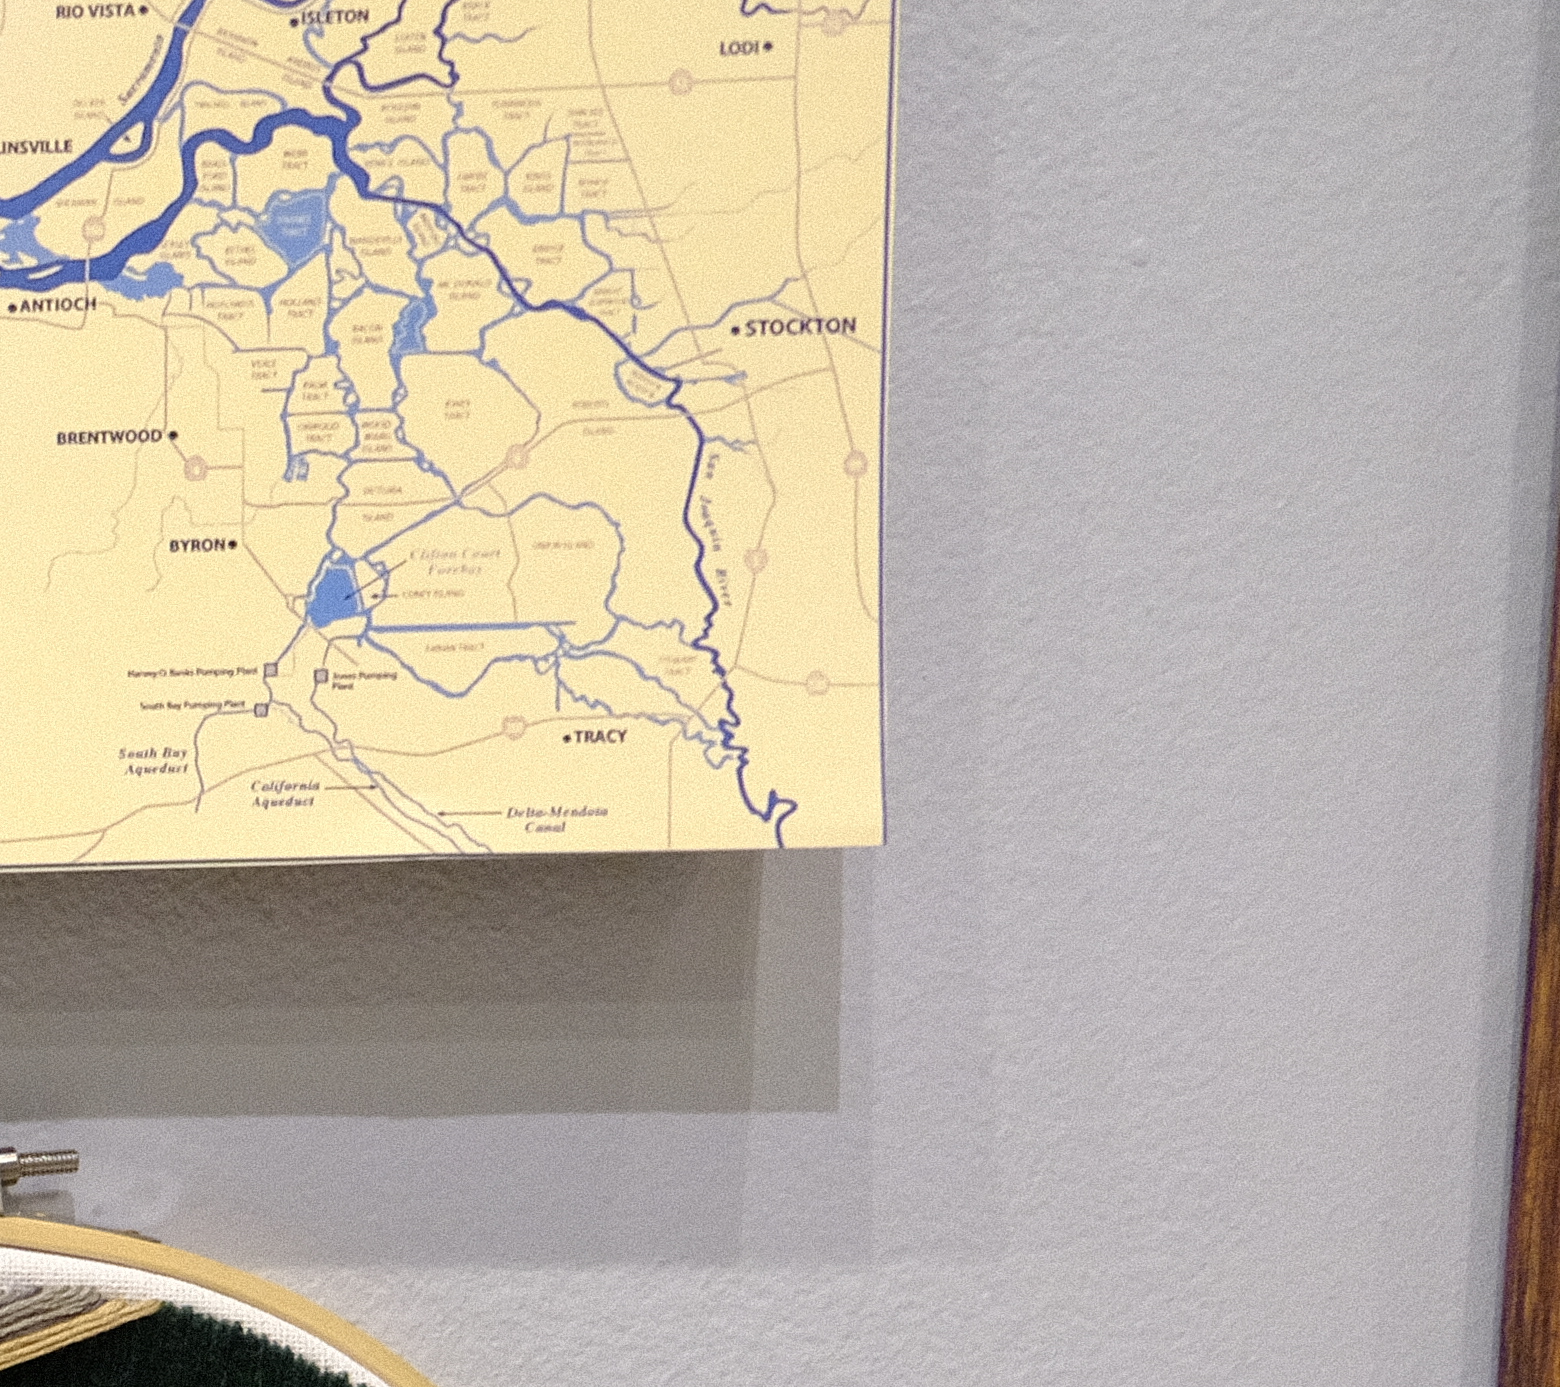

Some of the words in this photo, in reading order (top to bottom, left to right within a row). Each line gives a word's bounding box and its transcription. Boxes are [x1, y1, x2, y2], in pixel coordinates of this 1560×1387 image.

[55, 4, 84, 19] RIO
[87, 3, 136, 18] VISTA
[300, 9, 369, 25] ISLETON
[719, 40, 760, 56] LODI
[19, 297, 97, 313] ANTIOCH
[745, 318, 857, 336] STOCKTON
[56, 429, 163, 446] BRENTWOOD
[169, 538, 225, 552] BYRON
[575, 730, 627, 743] TRACY
